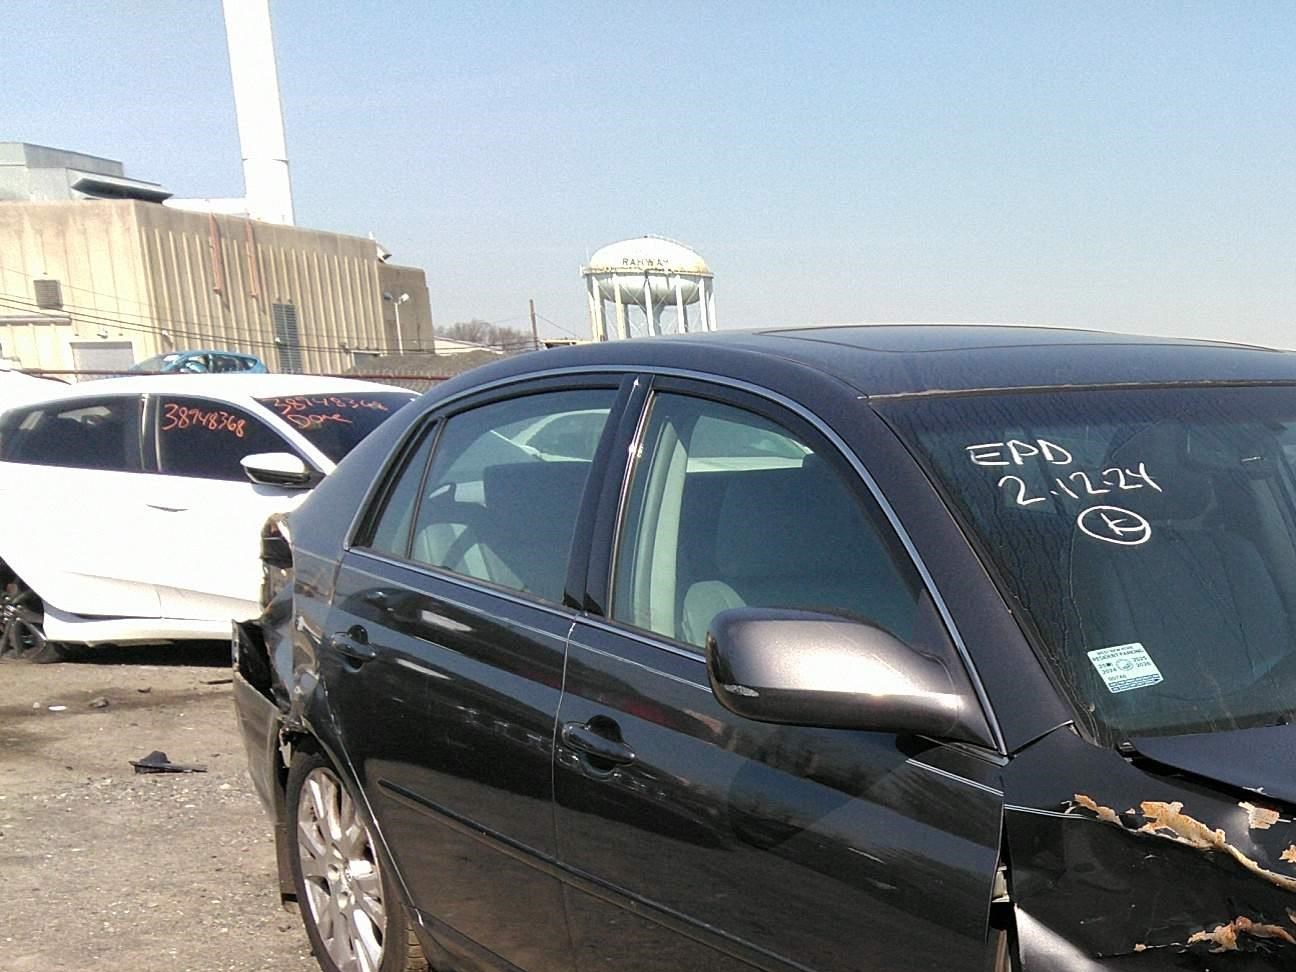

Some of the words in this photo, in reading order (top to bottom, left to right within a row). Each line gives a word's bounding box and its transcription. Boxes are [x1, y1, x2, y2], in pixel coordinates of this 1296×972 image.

[622, 257, 669, 267] RAHWAY
[162, 403, 248, 438] 38948368
[965, 439, 1073, 465] EPD
